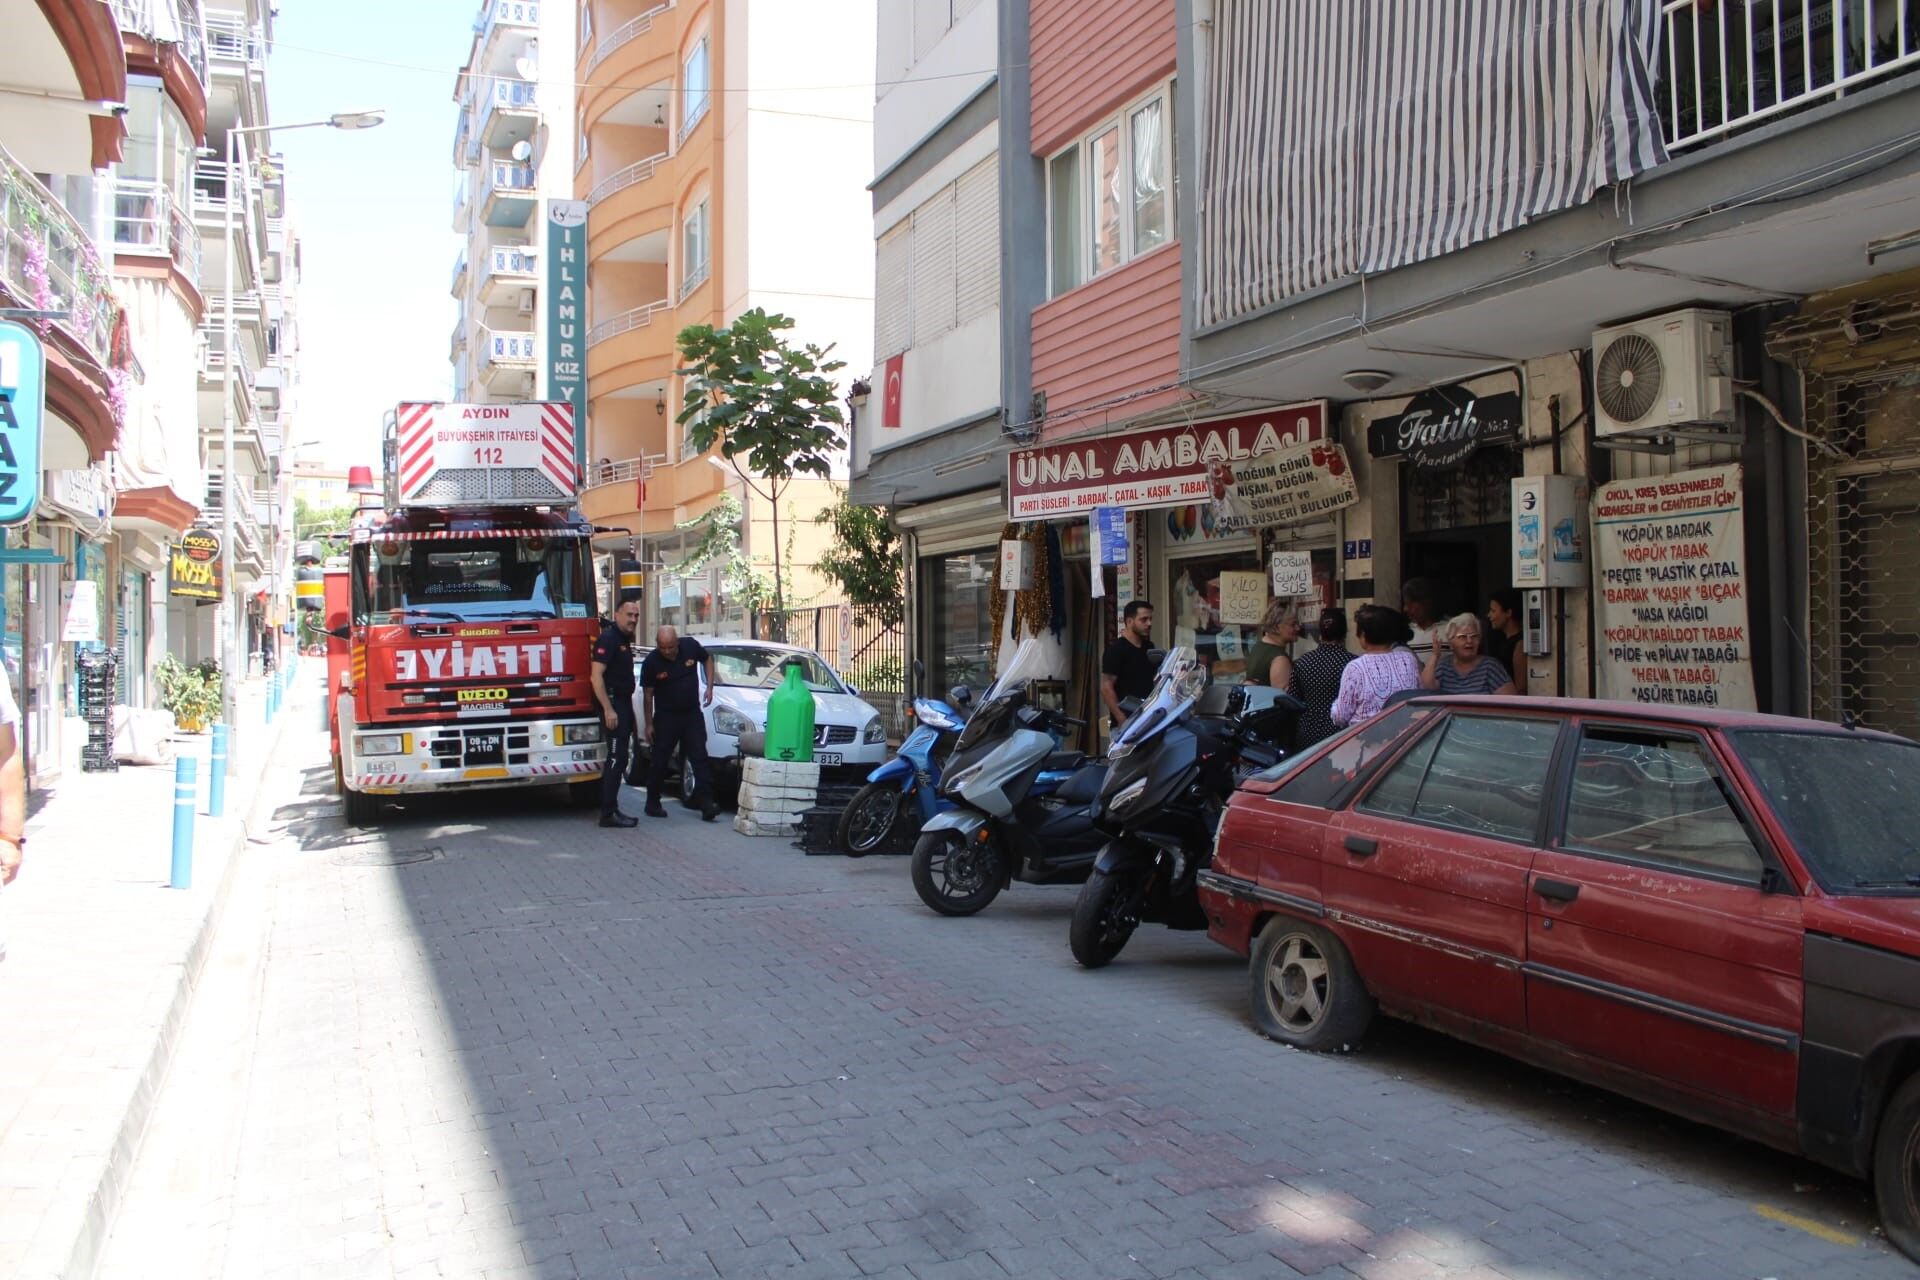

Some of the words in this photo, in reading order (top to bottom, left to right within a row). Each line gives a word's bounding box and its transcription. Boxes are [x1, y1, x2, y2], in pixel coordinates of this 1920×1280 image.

[559, 228, 576, 358] IHLAMUR
[554, 361, 580, 374] KIZ
[462, 408, 509, 419] AYDIN
[1397, 399, 1482, 450] Fatih
[437, 427, 495, 444] BÜYÜKŞEHİR
[497, 427, 539, 441] İTFAİYESİ
[473, 447, 503, 464] 112
[1015, 449, 1104, 488] ÜNAL
[1112, 416, 1310, 477] AMBALAJ
[1236, 465, 1276, 482] DOĞUM
[1279, 455, 1311, 474] GÜNÜ
[1275, 471, 1319, 491] DÜĞÜN,
[1606, 486, 1633, 501] OKUL,
[1635, 485, 1658, 500] KREŞ
[1660, 473, 1725, 496] BESLENMELERİ
[1019, 498, 1040, 513] PARTİ
[1041, 491, 1071, 510] SÜSLERİ
[1077, 490, 1108, 506] BARDAK
[1115, 488, 1139, 505] ÇATAL
[1147, 483, 1172, 501] KAŞIK
[1179, 480, 1209, 495] TABAK
[1250, 492, 1294, 510] SÜNNET
[1297, 490, 1311, 500] ve
[1648, 503, 1659, 513] ve
[1661, 494, 1712, 512] CEMİYETLER
[1251, 506, 1298, 526] SÜSLERİ
[1300, 490, 1353, 514] BULUNUR
[1665, 521, 1713, 539] BARDAK
[184, 536, 218, 548] MOSSA
[1670, 542, 1709, 560] TABAK
[1273, 556, 1309, 568] DOĞUM
[1699, 560, 1740, 582] ÇATAL
[1231, 575, 1258, 592] KİLO
[1275, 571, 1308, 583] GÜNÜ
[1281, 582, 1307, 594] SÜS
[1667, 602, 1708, 621] KAĞIDI
[460, 628, 500, 636] EuroFire
[1649, 624, 1700, 642] TABİLDOT
[1701, 625, 1744, 642] TABAK
[1645, 649, 1657, 660] ve
[1659, 644, 1690, 662] PİLAV
[1690, 643, 1739, 662] TABAĞI
[1672, 664, 1717, 684] TABAĞI
[457, 687, 508, 702] IVECO
[1675, 685, 1718, 705] TABAĞI
[461, 702, 505, 711] MAGIRUS
[820, 754, 840, 764] 812
